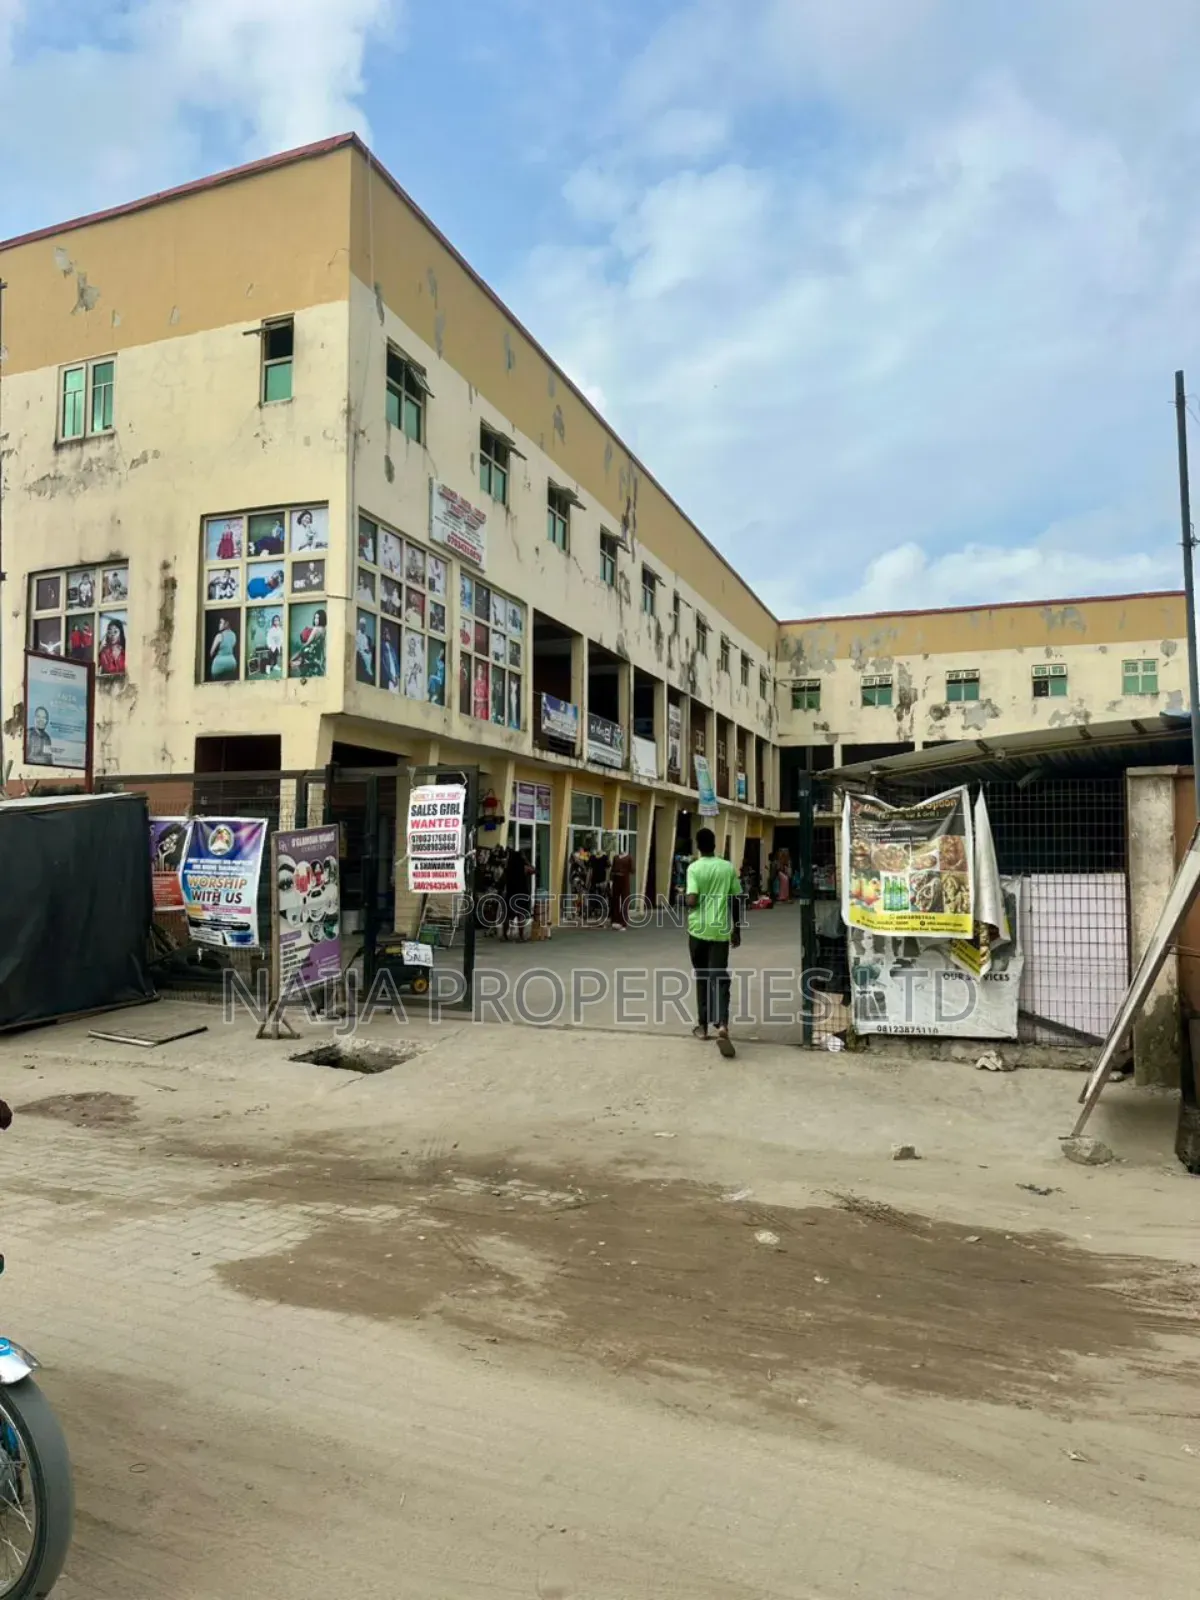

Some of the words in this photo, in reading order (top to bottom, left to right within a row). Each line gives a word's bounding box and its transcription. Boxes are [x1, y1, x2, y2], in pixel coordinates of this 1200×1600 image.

[411, 804, 439, 817] SALES
[440, 802, 461, 816] GIRL
[925, 798, 958, 811] Spoon
[411, 818, 460, 830] WANTED
[188, 875, 248, 890] WORSHIP
[192, 890, 222, 902] WITH
[225, 892, 243, 904] US
[943, 972, 965, 981] OUR
